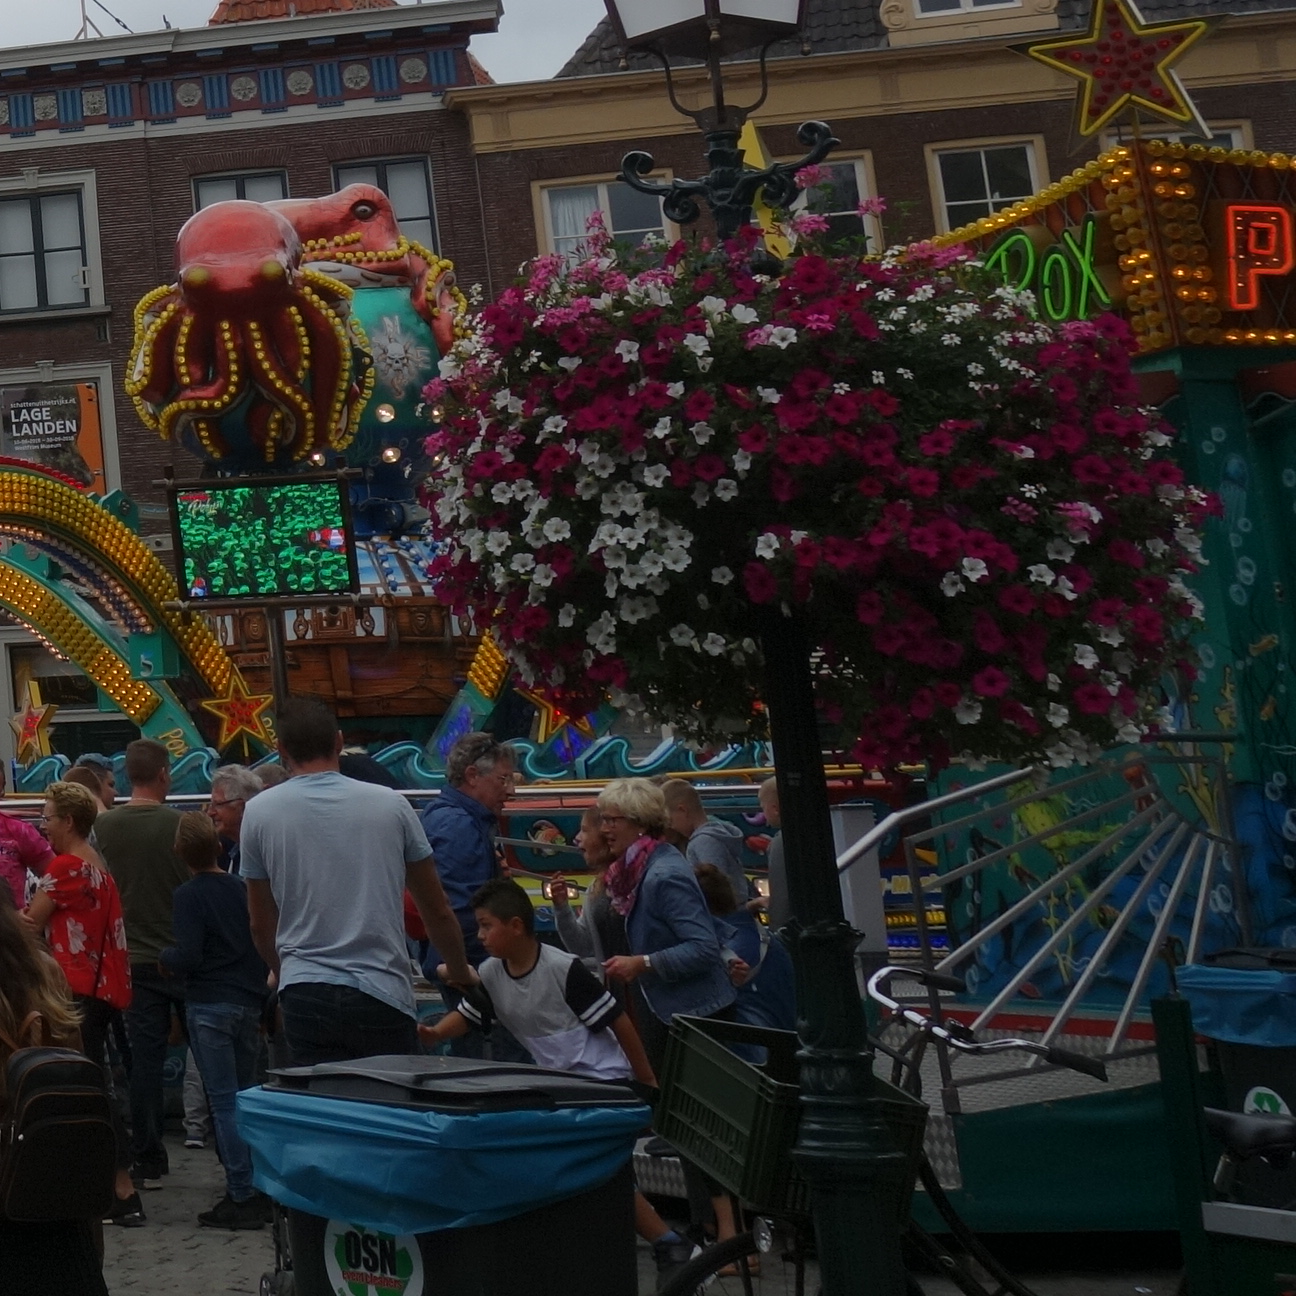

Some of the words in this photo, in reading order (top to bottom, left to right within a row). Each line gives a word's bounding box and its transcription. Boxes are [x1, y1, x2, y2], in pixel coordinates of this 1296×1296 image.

[10, 408, 51, 422] LAGE
[12, 420, 77, 437] LANDEN
[344, 1231, 397, 1275] OSN
